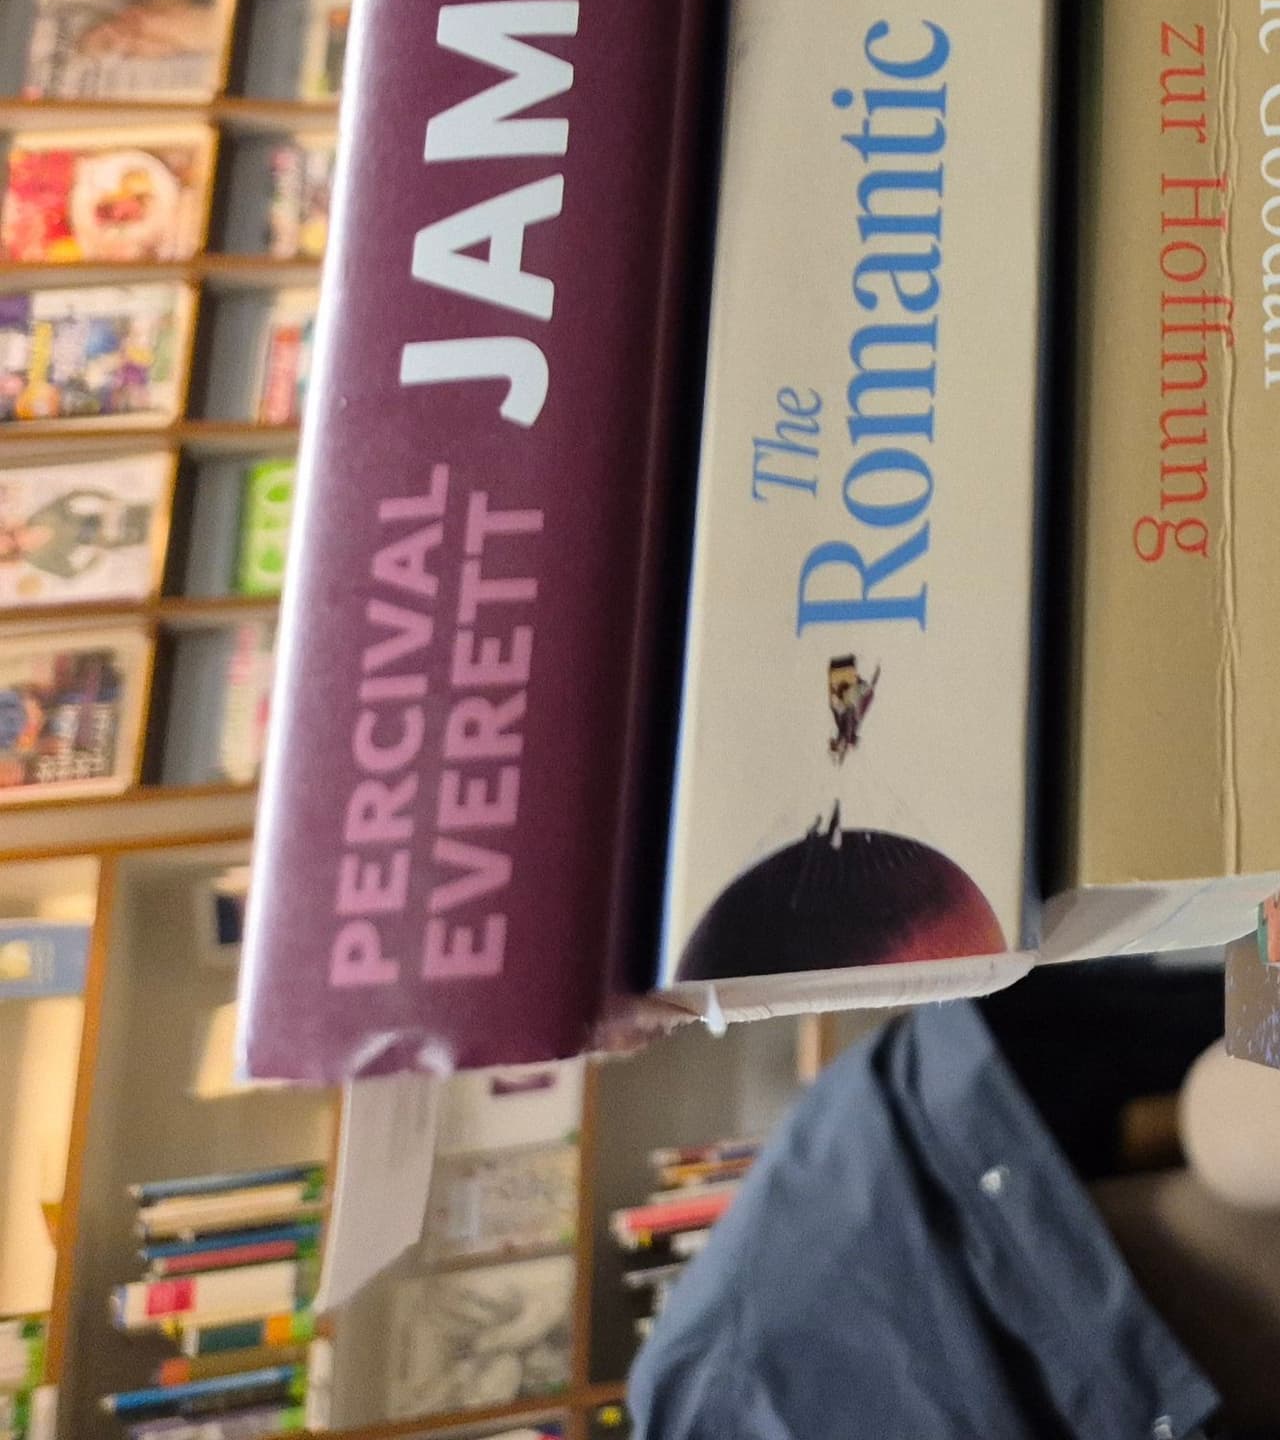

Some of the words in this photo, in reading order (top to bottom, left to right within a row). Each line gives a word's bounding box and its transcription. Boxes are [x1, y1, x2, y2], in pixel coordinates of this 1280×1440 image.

[1159, 21, 1207, 144] zur
[752, 386, 822, 502] The
[797, 18, 952, 634] Romantic
[1133, 173, 1236, 564] Hoffnung
[327, 463, 450, 987] PERCIVAL
[423, 490, 545, 982] EVERETT
